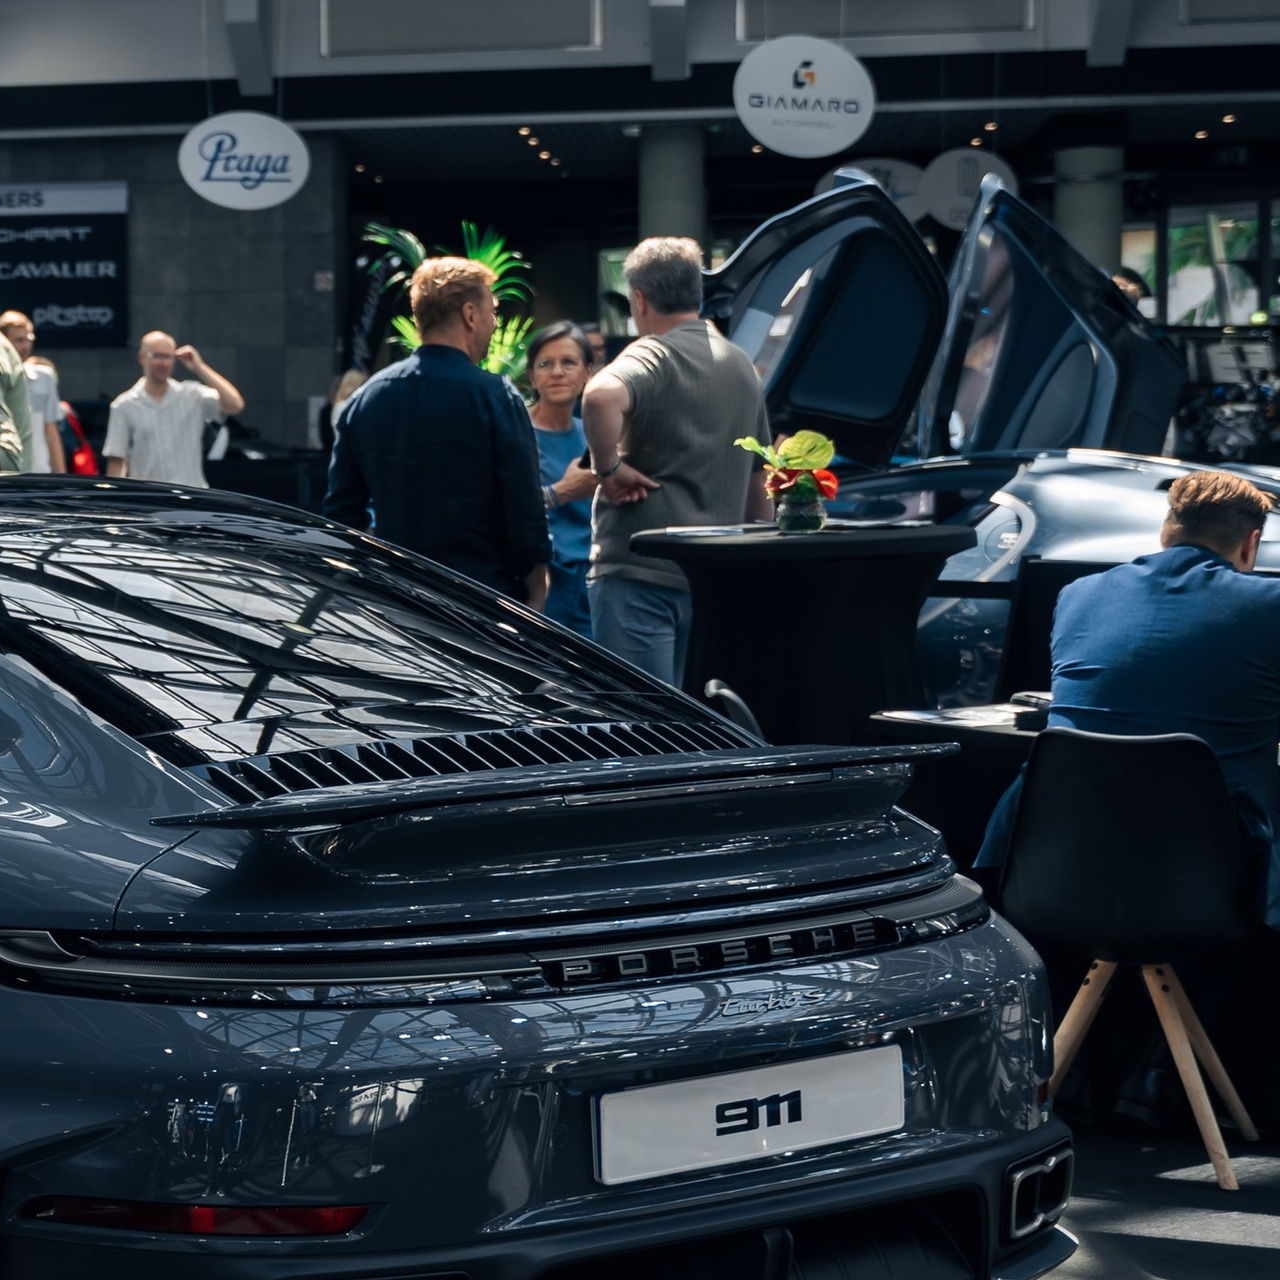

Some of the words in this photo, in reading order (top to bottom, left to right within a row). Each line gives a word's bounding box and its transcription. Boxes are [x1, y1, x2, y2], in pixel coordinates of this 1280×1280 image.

[748, 95, 860, 114] GIAMARO
[198, 130, 291, 190] Praga
[561, 922, 878, 982] PORSCHE
[721, 993, 798, 1016] turbo
[715, 1089, 803, 1137] 911
